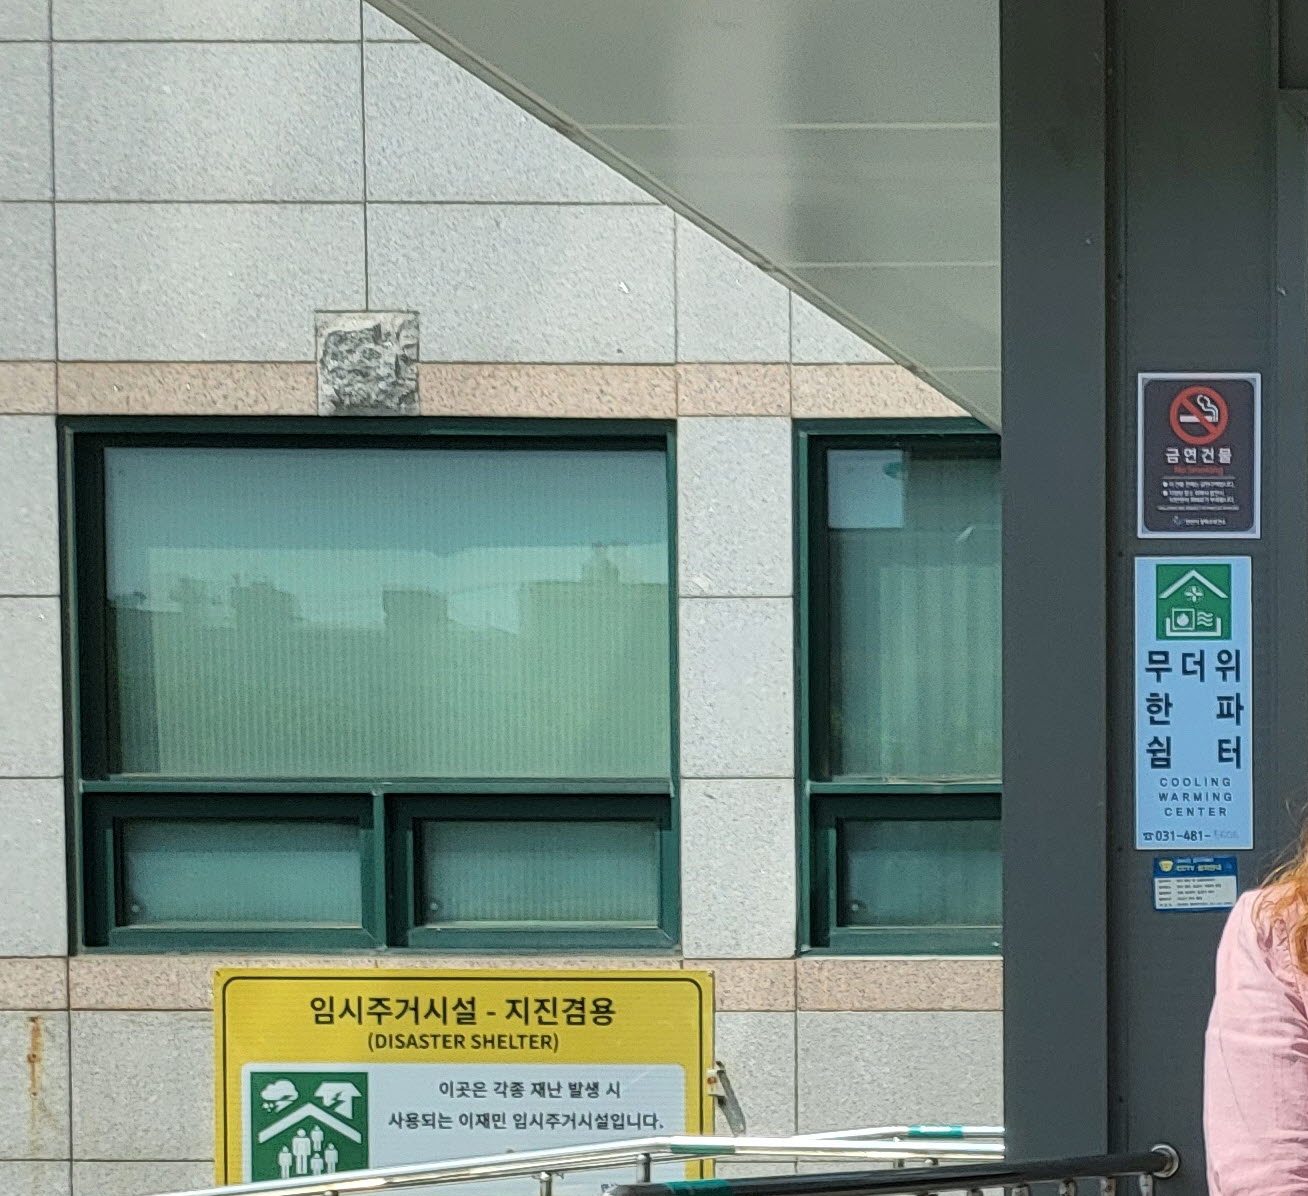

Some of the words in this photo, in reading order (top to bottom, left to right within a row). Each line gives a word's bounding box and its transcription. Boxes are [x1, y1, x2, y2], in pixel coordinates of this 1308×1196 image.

[1165, 447, 1232, 464] 금연건물
[1145, 649, 1241, 682] 무더위
[1159, 777, 1231, 787] COOLING
[1158, 792, 1232, 802] WARMING
[1164, 807, 1227, 817] CENTER
[310, 997, 477, 1026] 임시주거시설
[505, 997, 616, 1027] 지진겸용
[368, 1032, 465, 1052] (DISASTER
[471, 1032, 559, 1053] SHELTER)
[440, 1080, 487, 1099] 이곳은
[493, 1080, 524, 1098] 각종
[530, 1080, 562, 1098] 재난
[568, 1080, 600, 1098] 발생
[606, 1080, 621, 1098] 시
[388, 1111, 453, 1130] 사용되는
[459, 1111, 507, 1130] 이재민
[513, 1111, 664, 1131] 임시주거시설입니다.
